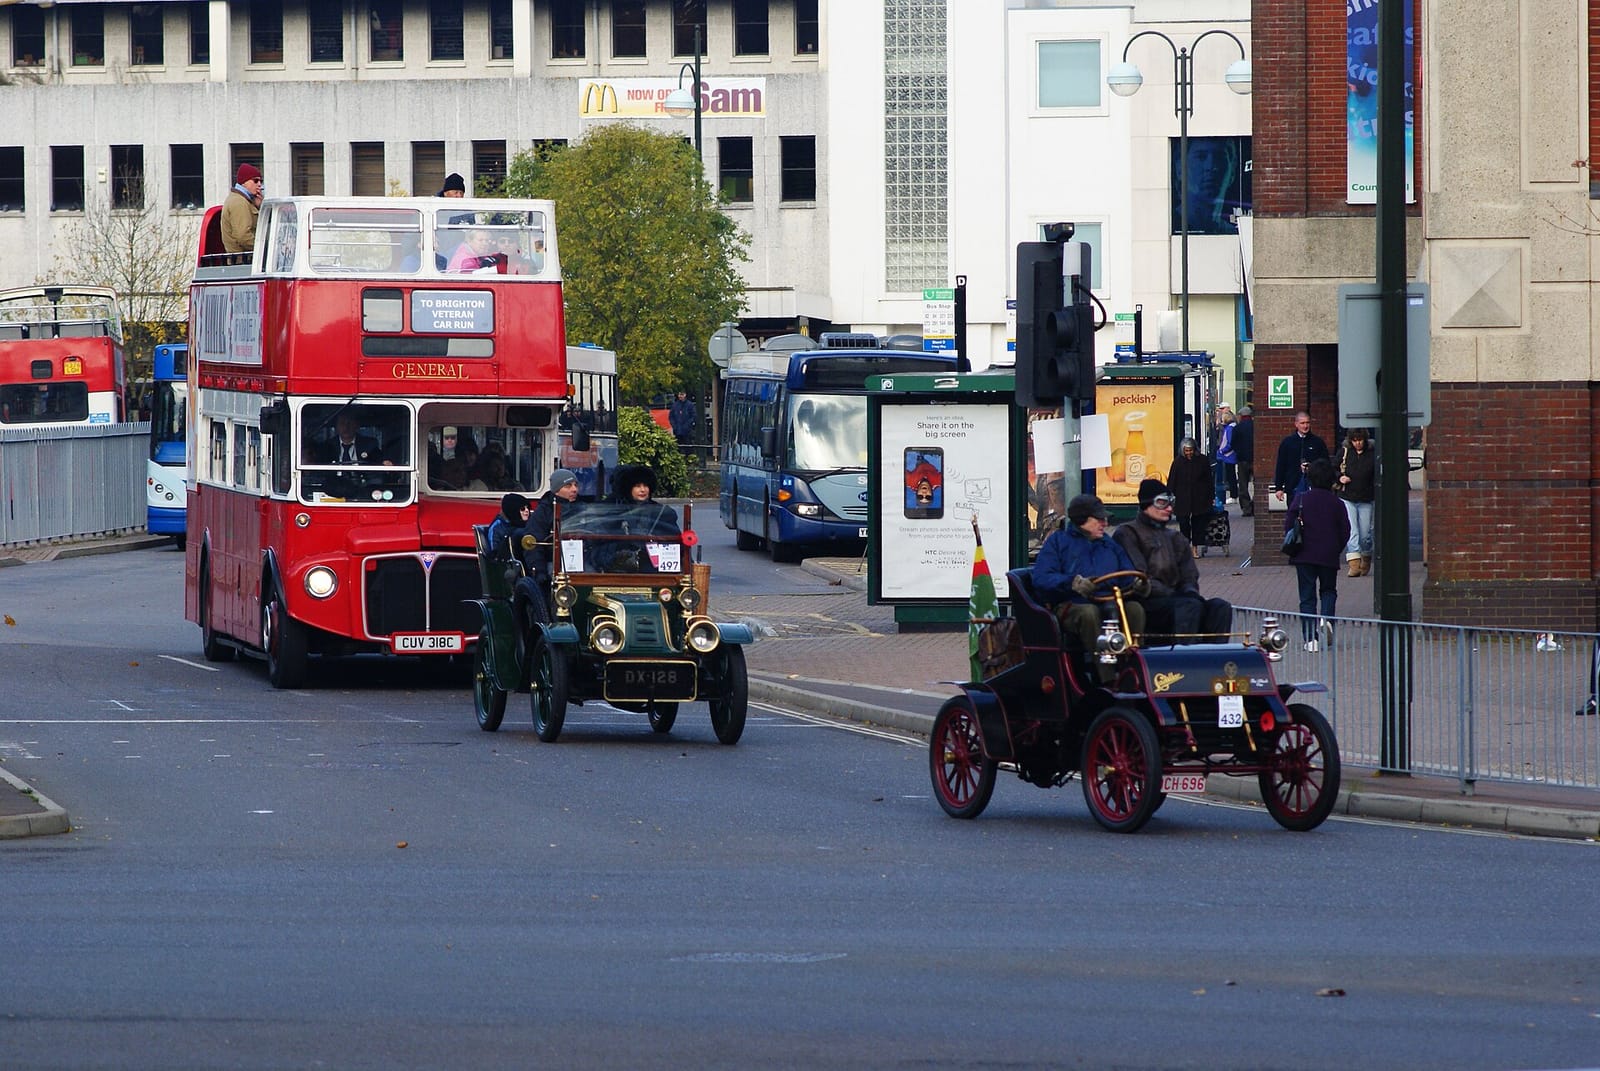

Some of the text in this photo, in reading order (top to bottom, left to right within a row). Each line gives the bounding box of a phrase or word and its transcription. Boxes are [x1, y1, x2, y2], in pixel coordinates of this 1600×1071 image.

[627, 89, 675, 101] NOW OP
[958, 277, 965, 286] D
[421, 300, 485, 308] TO BRIGHTON
[432, 310, 474, 319] VETERAN
[433, 320, 474, 329] CAR RUN
[392, 363, 470, 379] GENERAL
[1113, 394, 1157, 406] peckish?
[925, 431, 938, 439] big
[660, 561, 679, 571] 497
[402, 637, 454, 648] CUV 318C
[1221, 713, 1242, 725] 432
[1161, 777, 1204, 790] CH-696
